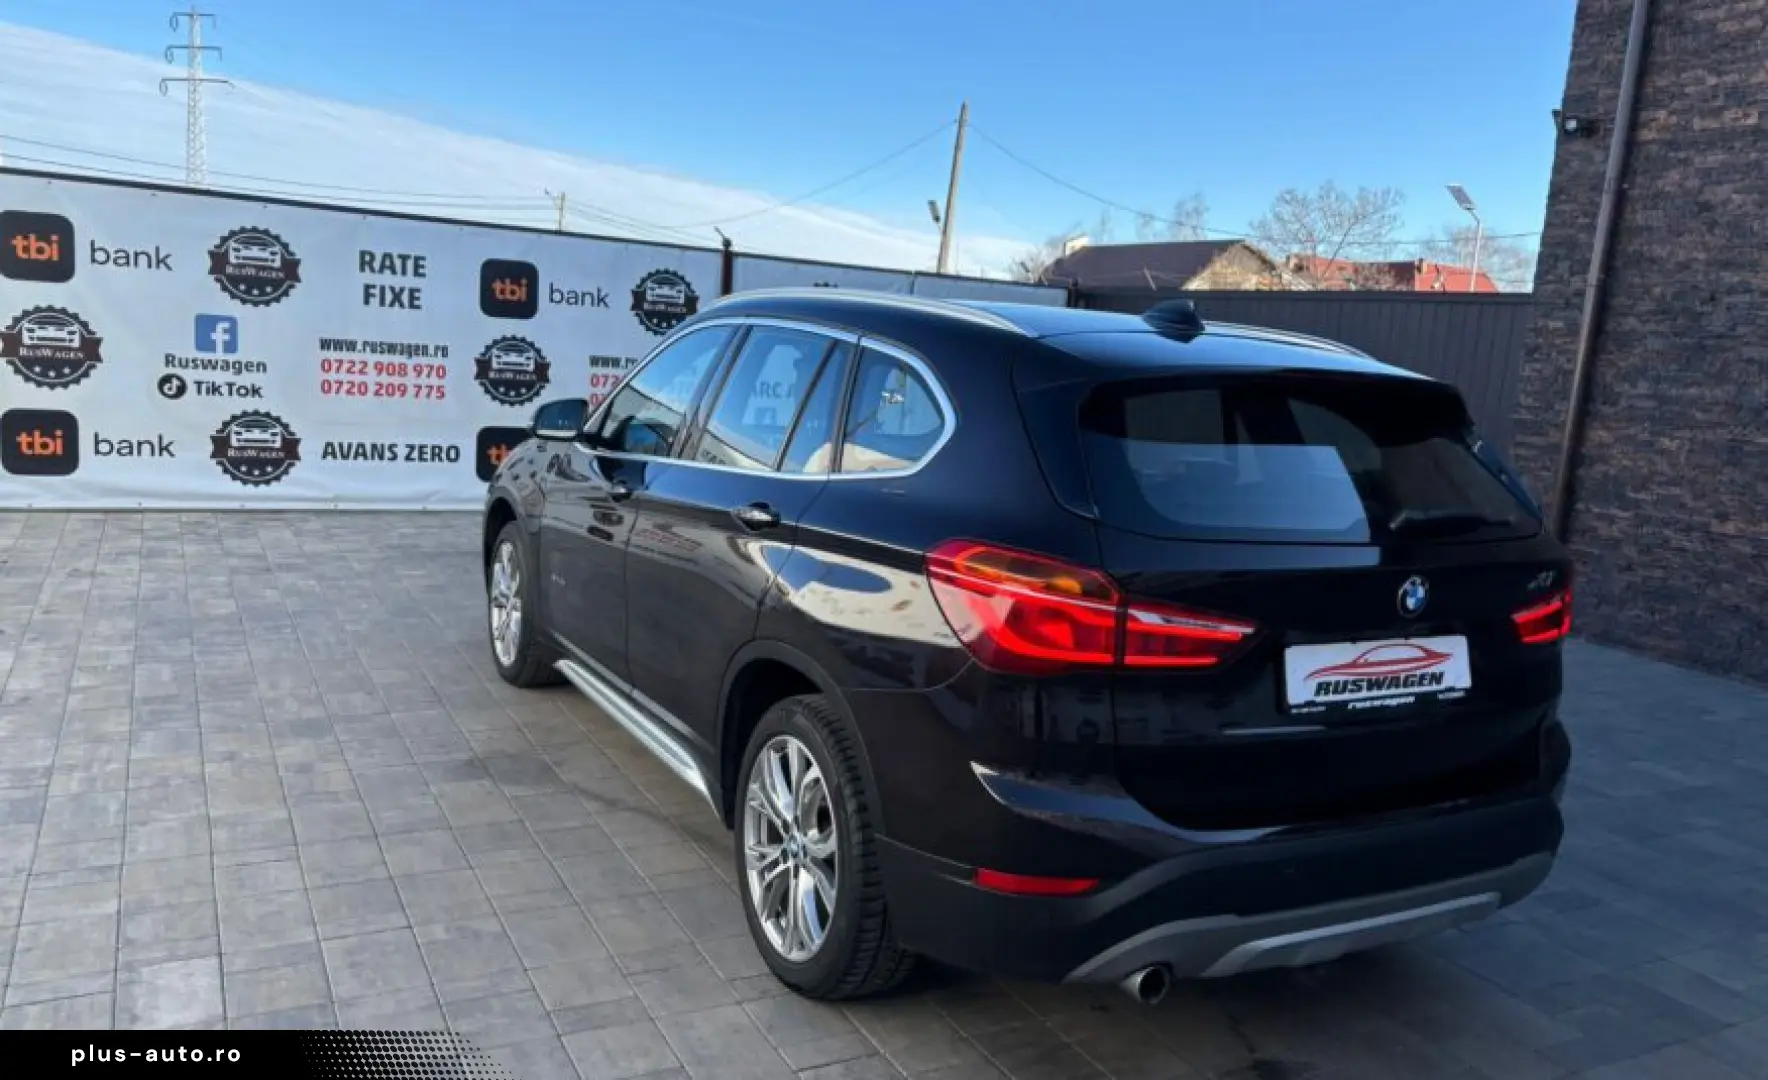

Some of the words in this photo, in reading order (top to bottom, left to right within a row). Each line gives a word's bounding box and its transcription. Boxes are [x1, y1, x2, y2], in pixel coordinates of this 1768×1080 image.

[12, 234, 60, 261] tbi
[90, 240, 173, 271] bank
[359, 250, 427, 278] RATE
[363, 283, 422, 310] FIXE
[492, 278, 529, 302] tbi
[549, 283, 610, 309] bank
[319, 338, 449, 359] www.ruswagen.ro
[165, 354, 268, 375] Ruswagen
[321, 359, 368, 375] 0722
[373, 361, 408, 377] 908
[413, 363, 447, 380] 970
[194, 380, 264, 398] TikTok
[321, 379, 368, 397] 0720
[373, 382, 408, 399] 209
[413, 384, 446, 400] 775
[16, 430, 63, 455] tbi
[93, 433, 176, 458] bank
[321, 442, 398, 461] AVANS
[404, 444, 461, 463] ZERO
[1313, 671, 1444, 697] RUSWAGEN
